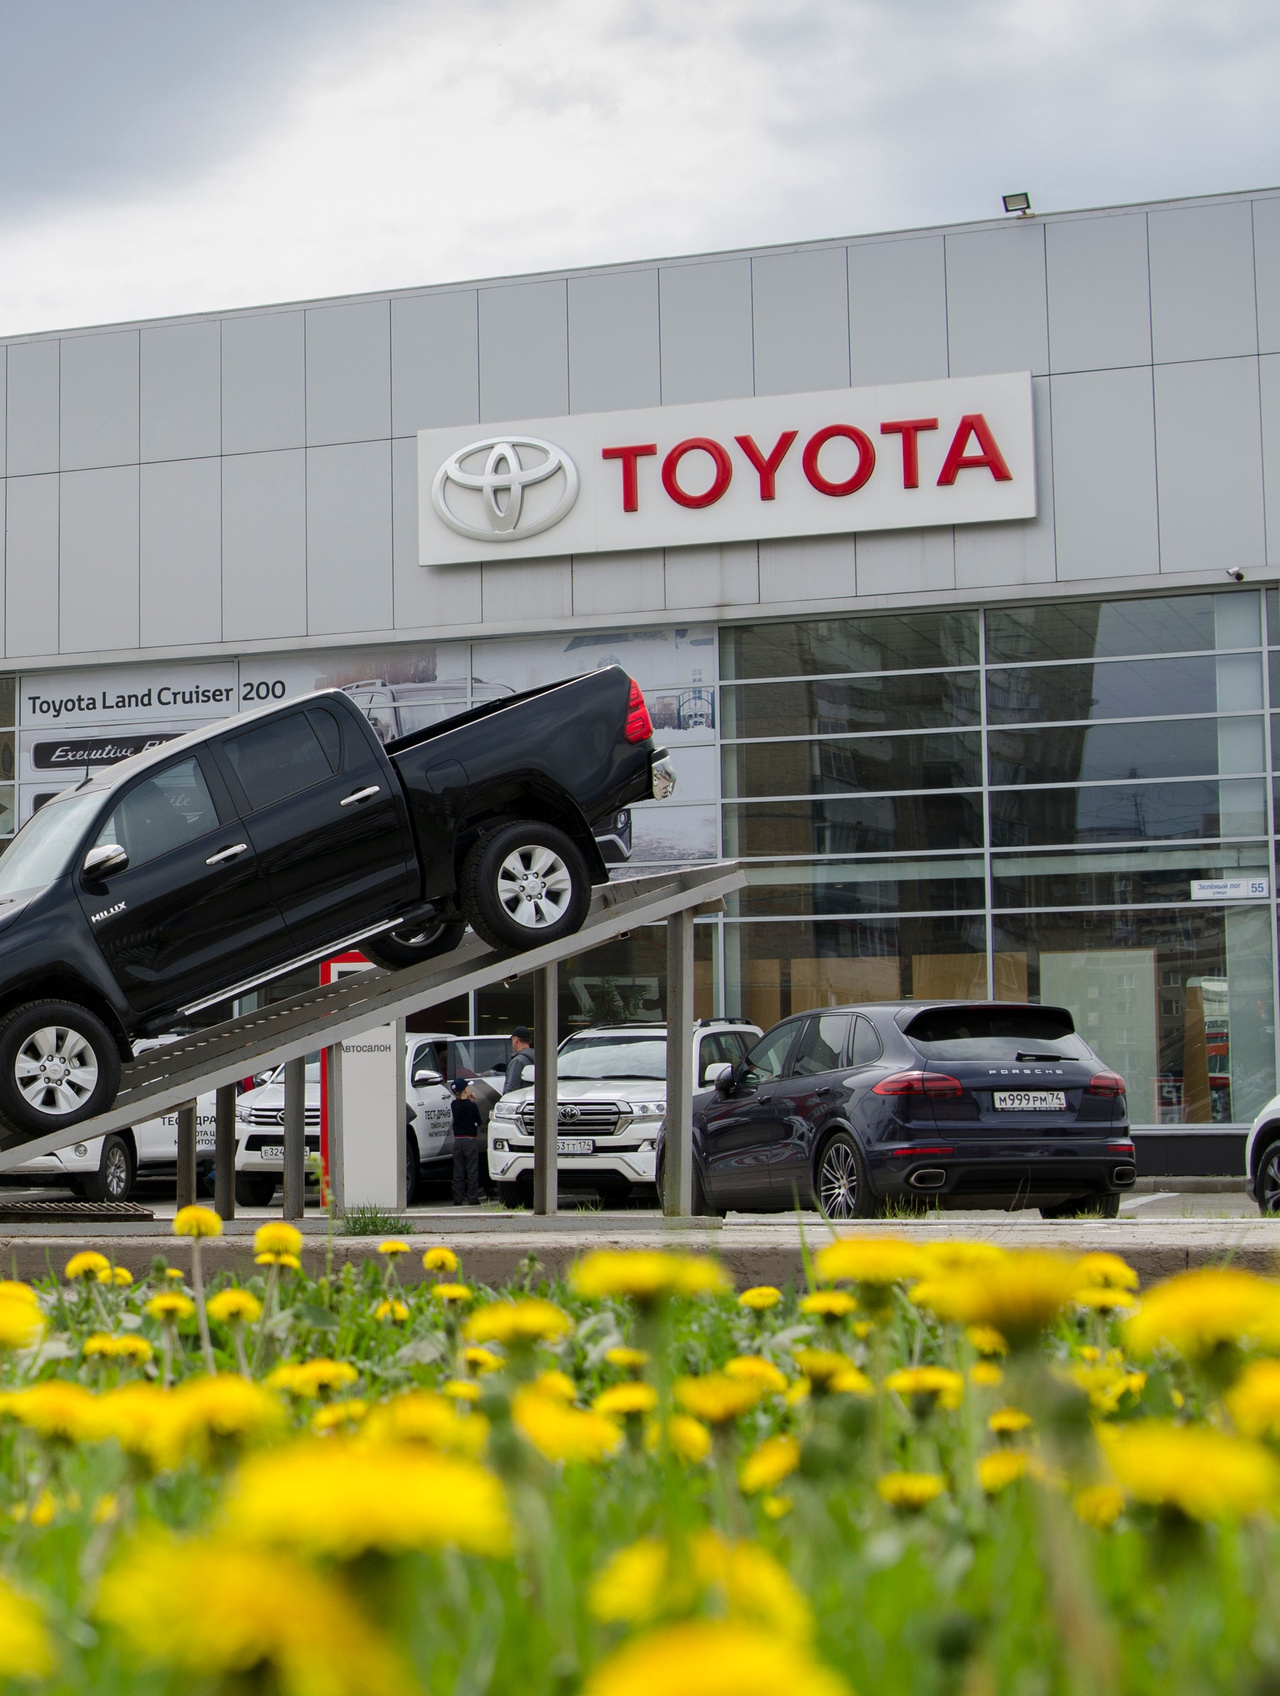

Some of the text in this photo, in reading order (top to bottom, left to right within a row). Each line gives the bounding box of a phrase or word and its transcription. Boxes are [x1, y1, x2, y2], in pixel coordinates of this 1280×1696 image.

[601, 412, 1014, 513] TOYOTA
[28, 680, 287, 718] Toyota Land Cruiser 200
[50, 746, 135, 763] Executive
[1197, 882, 1228, 890] Зелёный
[1250, 882, 1264, 893] 55
[90, 900, 128, 924] HILUX
